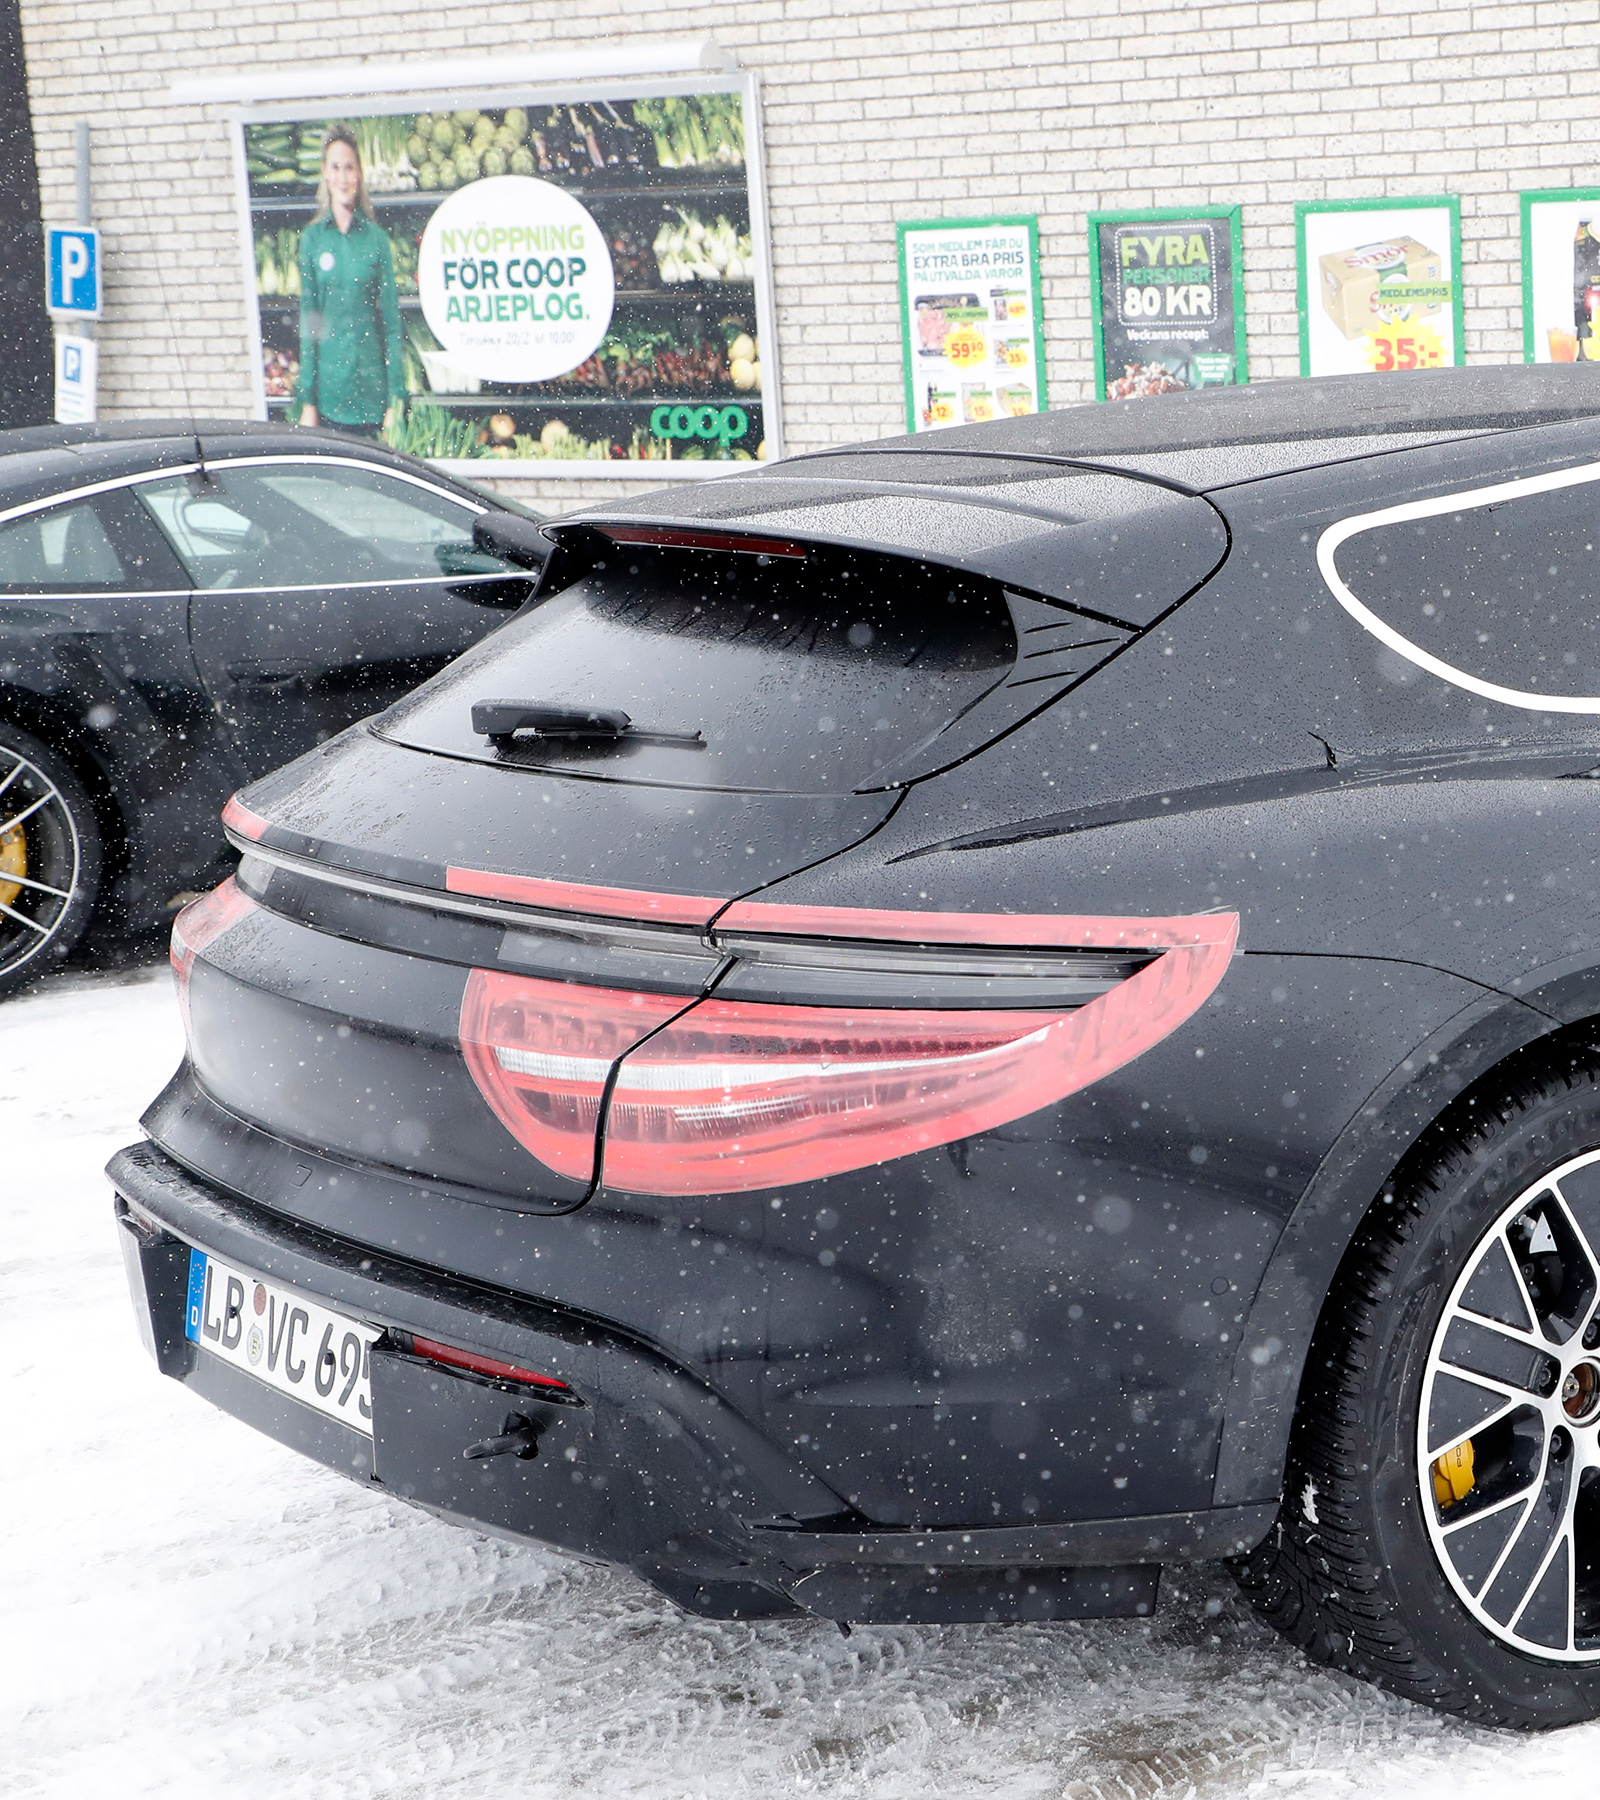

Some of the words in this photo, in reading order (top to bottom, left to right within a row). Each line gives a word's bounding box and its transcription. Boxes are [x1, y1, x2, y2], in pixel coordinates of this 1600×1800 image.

[441, 221, 585, 254] NYÖPPNING
[912, 242, 935, 254] SOM
[938, 240, 982, 253] MEDLEM
[985, 237, 1007, 250] FÅR
[1008, 238, 1023, 249] DU
[1120, 234, 1210, 267] FYRA
[61, 235, 89, 305] P
[443, 257, 499, 290] FÖR
[506, 257, 587, 289] COOP
[913, 254, 958, 269] EXTRA
[961, 253, 990, 267] BRA
[993, 251, 1024, 265] PRIS
[930, 269, 981, 283] UTVALDA
[1122, 267, 1211, 285] PERSONER
[446, 292, 591, 323] ARJEPLOG.
[1124, 286, 1162, 317] 80
[1166, 285, 1212, 316] KR
[1379, 287, 1448, 298] MEDLEMSPRIS
[1127, 330, 1171, 341] Veckans
[650, 405, 749, 447] coop
[190, 1305, 199, 1326] D
[202, 1265, 245, 1350] LB
[267, 1294, 309, 1384] VC
